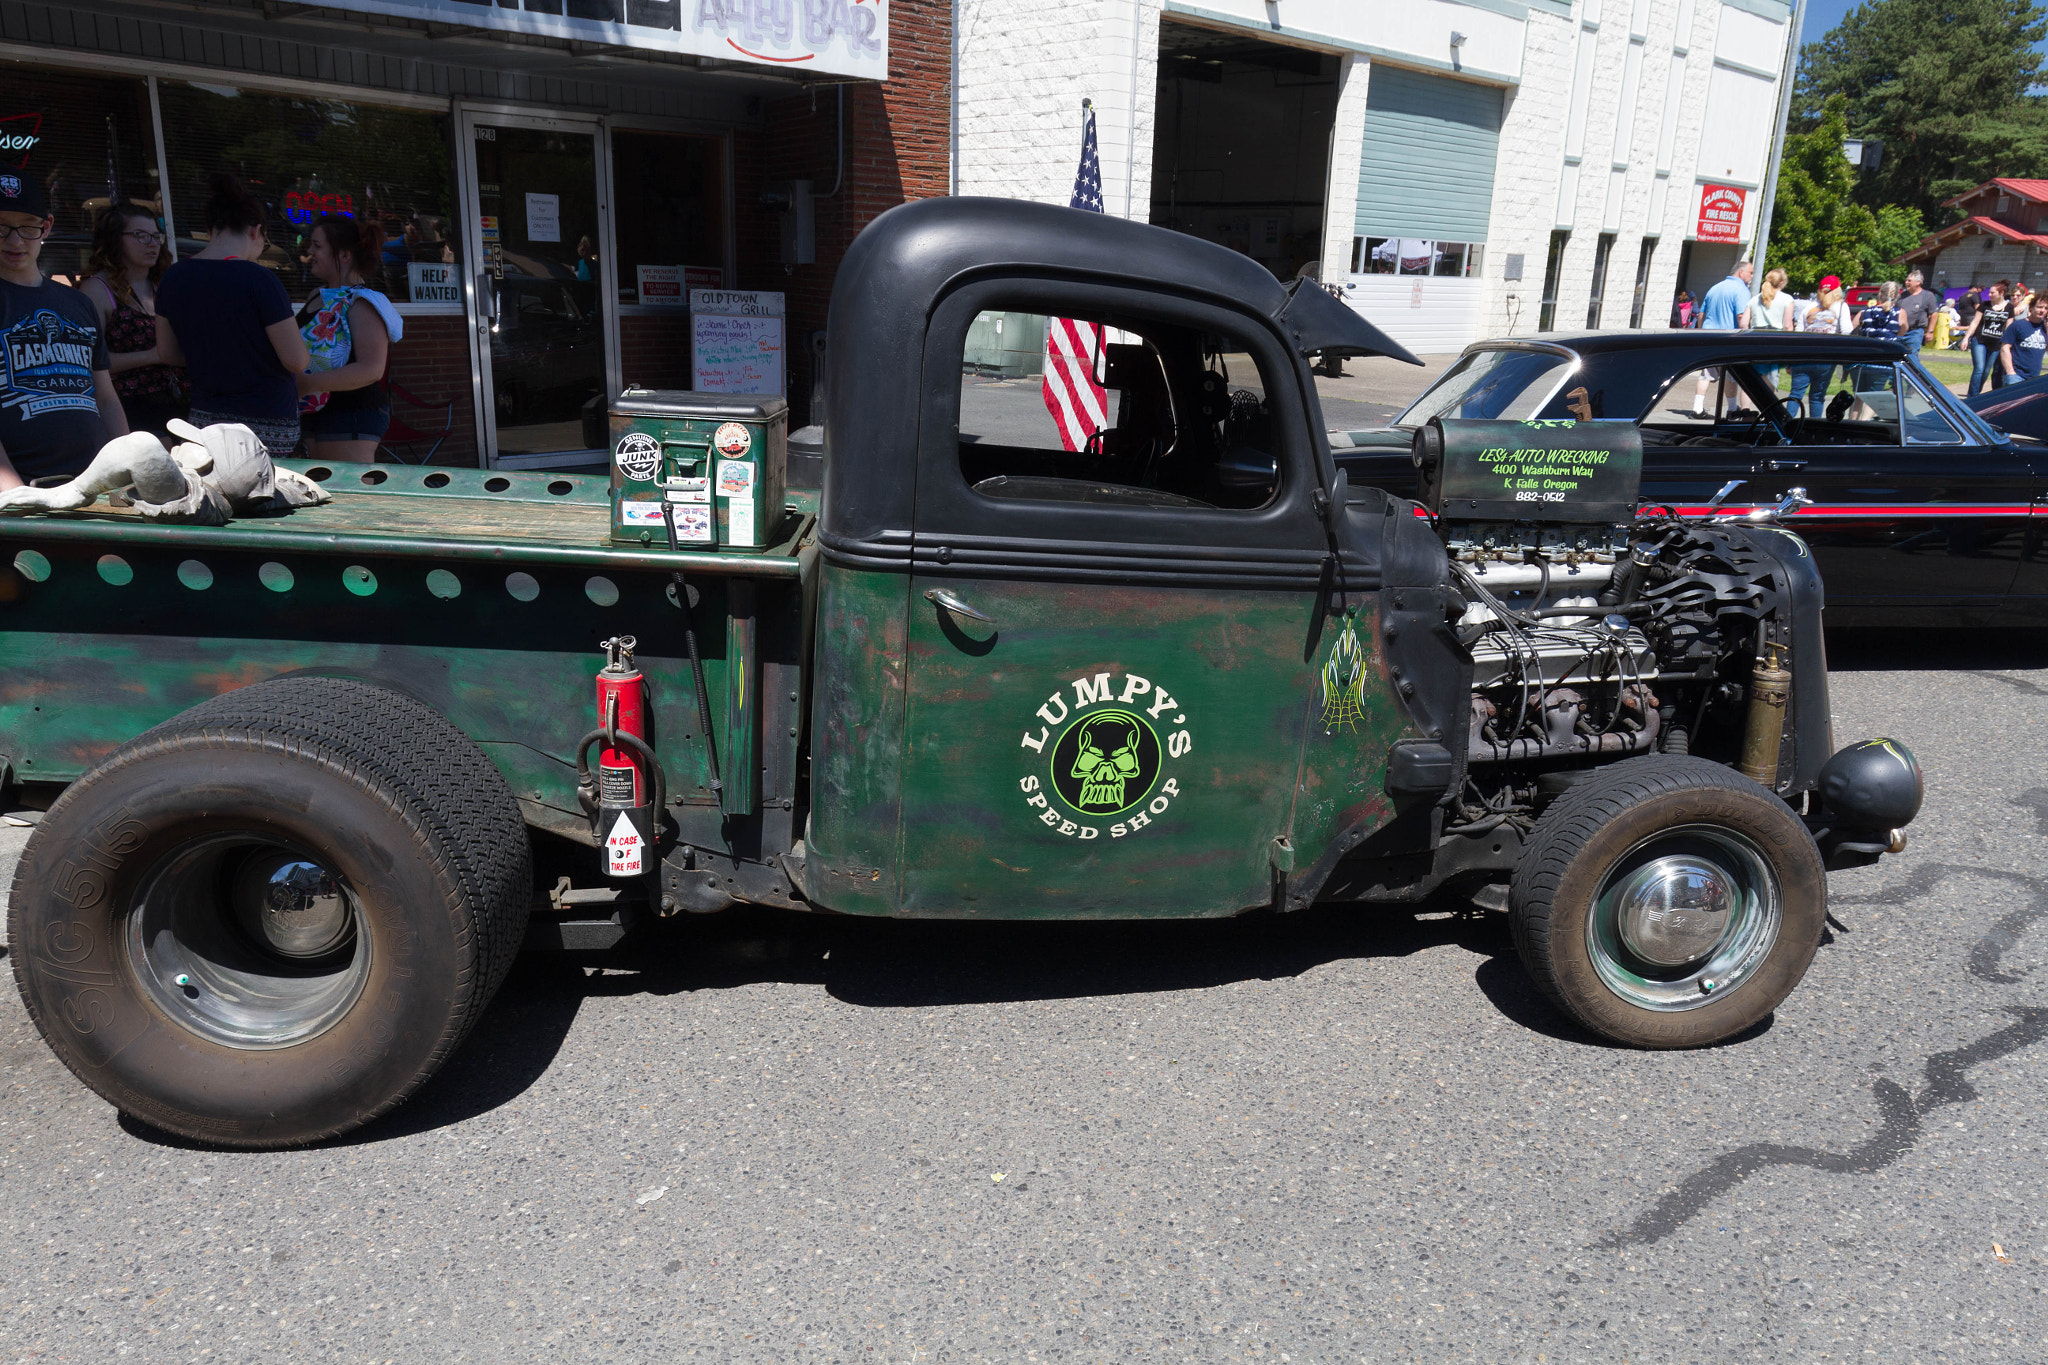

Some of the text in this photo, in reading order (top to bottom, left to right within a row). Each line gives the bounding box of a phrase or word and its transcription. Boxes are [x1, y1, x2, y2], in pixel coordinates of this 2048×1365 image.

[804, 0, 882, 52] BAR
[476, 128, 495, 140] 128
[1, 177, 18, 186] 25
[1703, 189, 1743, 210] CLARK COUNTY
[286, 191, 354, 224] OPEN
[1705, 209, 1738, 221] FIRE RESCUE
[1702, 223, 1713, 231] FIRE
[1713, 224, 1731, 233] STATION
[421, 268, 449, 283] HELP
[414, 286, 458, 300] WANTED
[2020, 340, 2047, 350] adidas
[717, 423, 748, 435] HOT ROD
[625, 434, 654, 445] GENUINE
[623, 452, 656, 463] JUNK
[1508, 450, 1544, 463] AUTO
[1547, 450, 1610, 464] WRECKING
[1492, 465, 1594, 478] 4100 Washburn Way
[1504, 478, 1578, 491] K Falls Oregon
[1515, 491, 1565, 502] 882-0512
[1020, 672, 1192, 759] LUMPY'S
[1019, 775, 1180, 840] SPEED SHOP
[1695, 803, 1802, 861] DUNLOP
[610, 835, 638, 846] IN CASE
[611, 860, 640, 871] TIRE FIRE
[1669, 915, 1709, 931] Ford
[1567, 960, 1711, 1038] SIGNATURE
